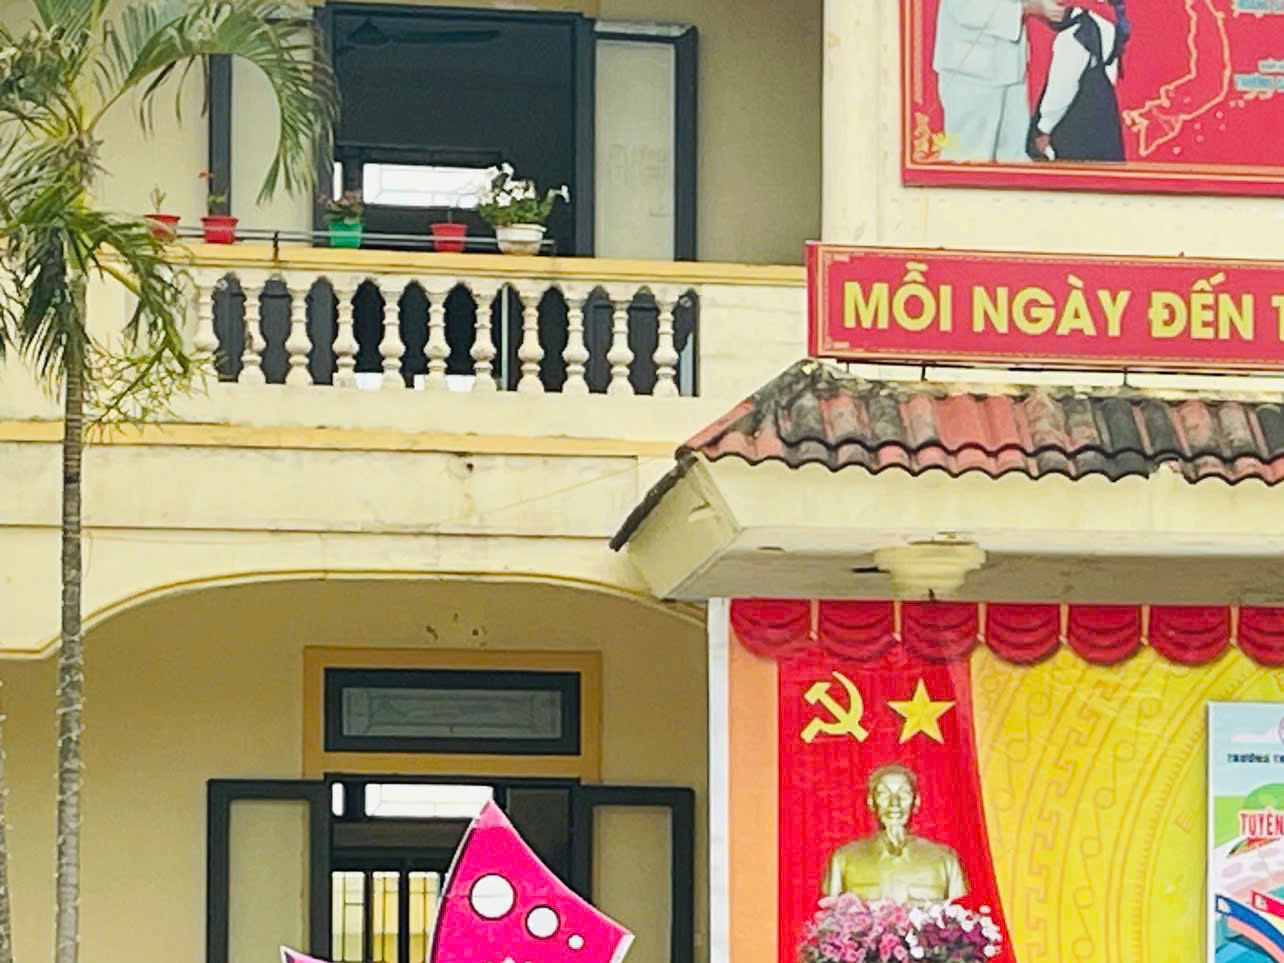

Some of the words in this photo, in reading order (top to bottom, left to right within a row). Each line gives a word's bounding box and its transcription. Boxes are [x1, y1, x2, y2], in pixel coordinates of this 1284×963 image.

[843, 261, 952, 333] MỖI
[973, 274, 1131, 338] NGÀY
[1149, 272, 1254, 341] ĐẾN
[1240, 808, 1284, 836] TUYÊN
